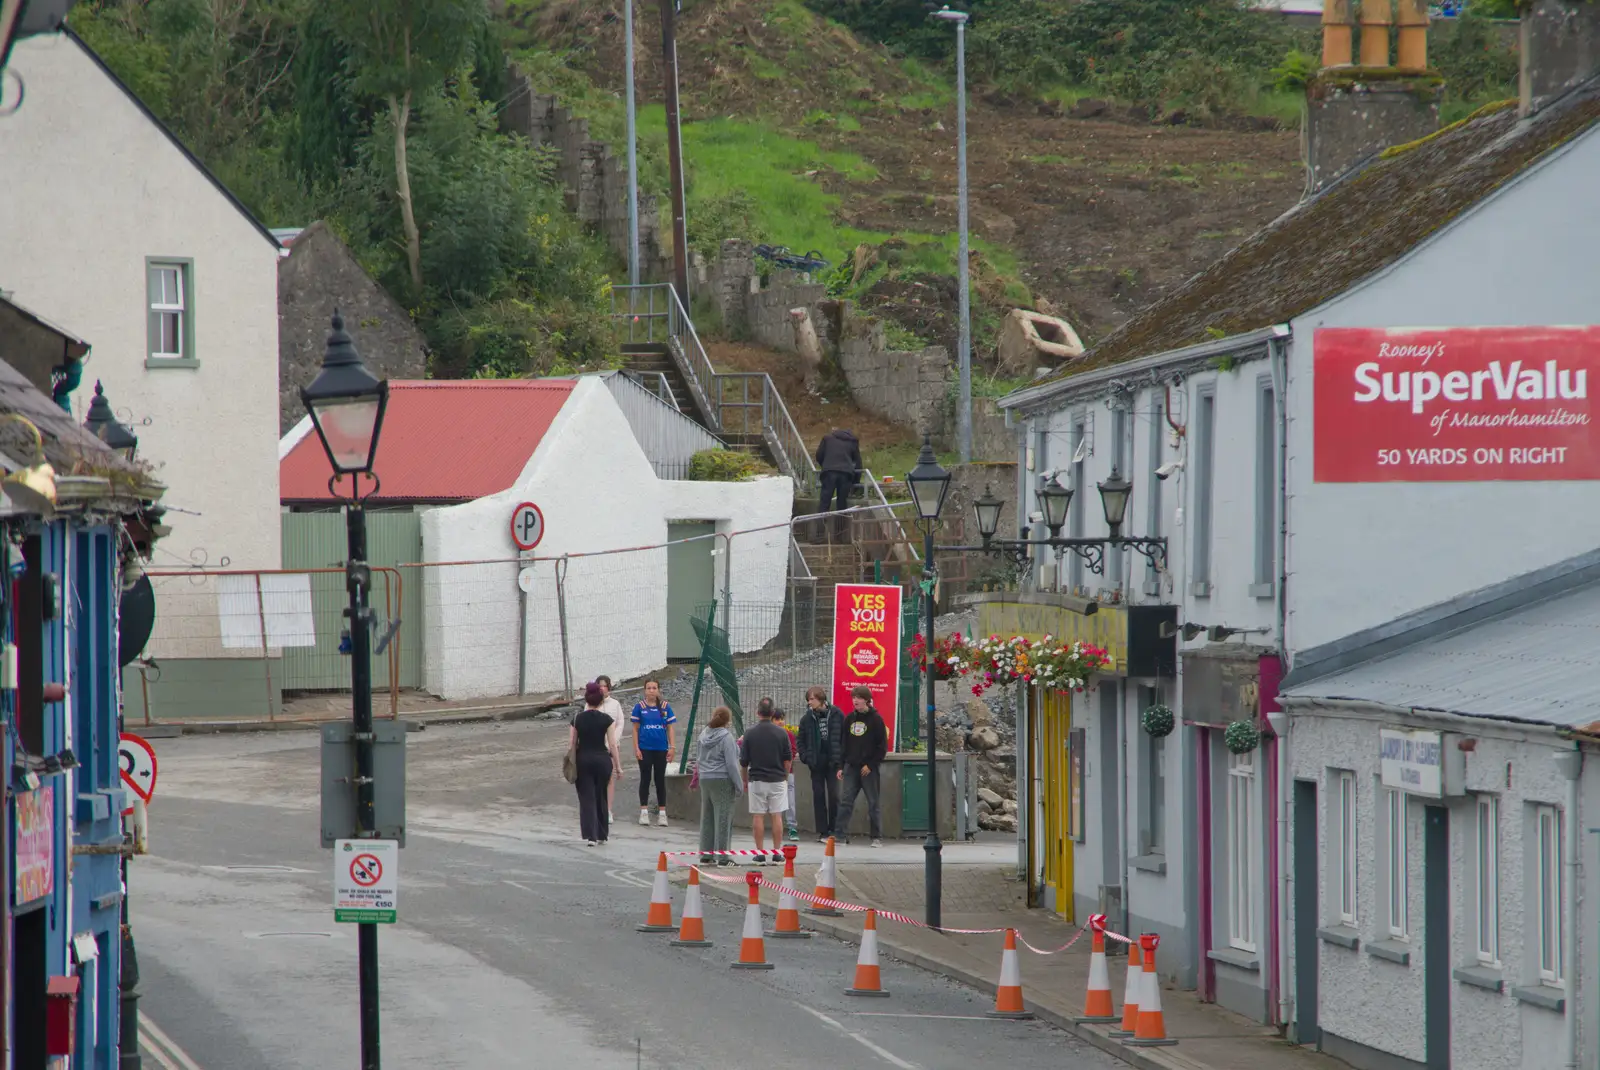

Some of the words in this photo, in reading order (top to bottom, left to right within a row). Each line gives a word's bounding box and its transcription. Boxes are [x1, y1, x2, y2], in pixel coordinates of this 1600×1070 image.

[1378, 341, 1446, 366] Rooney's
[1354, 360, 1587, 414] SuperValu
[1430, 409, 1450, 436] of
[1449, 408, 1591, 428] Manorhamilton
[1377, 449, 1400, 465] 50
[1407, 448, 1467, 465] YARDS
[1473, 447, 1503, 464] ON
[1509, 446, 1567, 464] RIGHT
[524, 511, 536, 540] P
[852, 593, 885, 609] YES
[851, 609, 885, 622] YOU
[850, 622, 885, 632] SCAN
